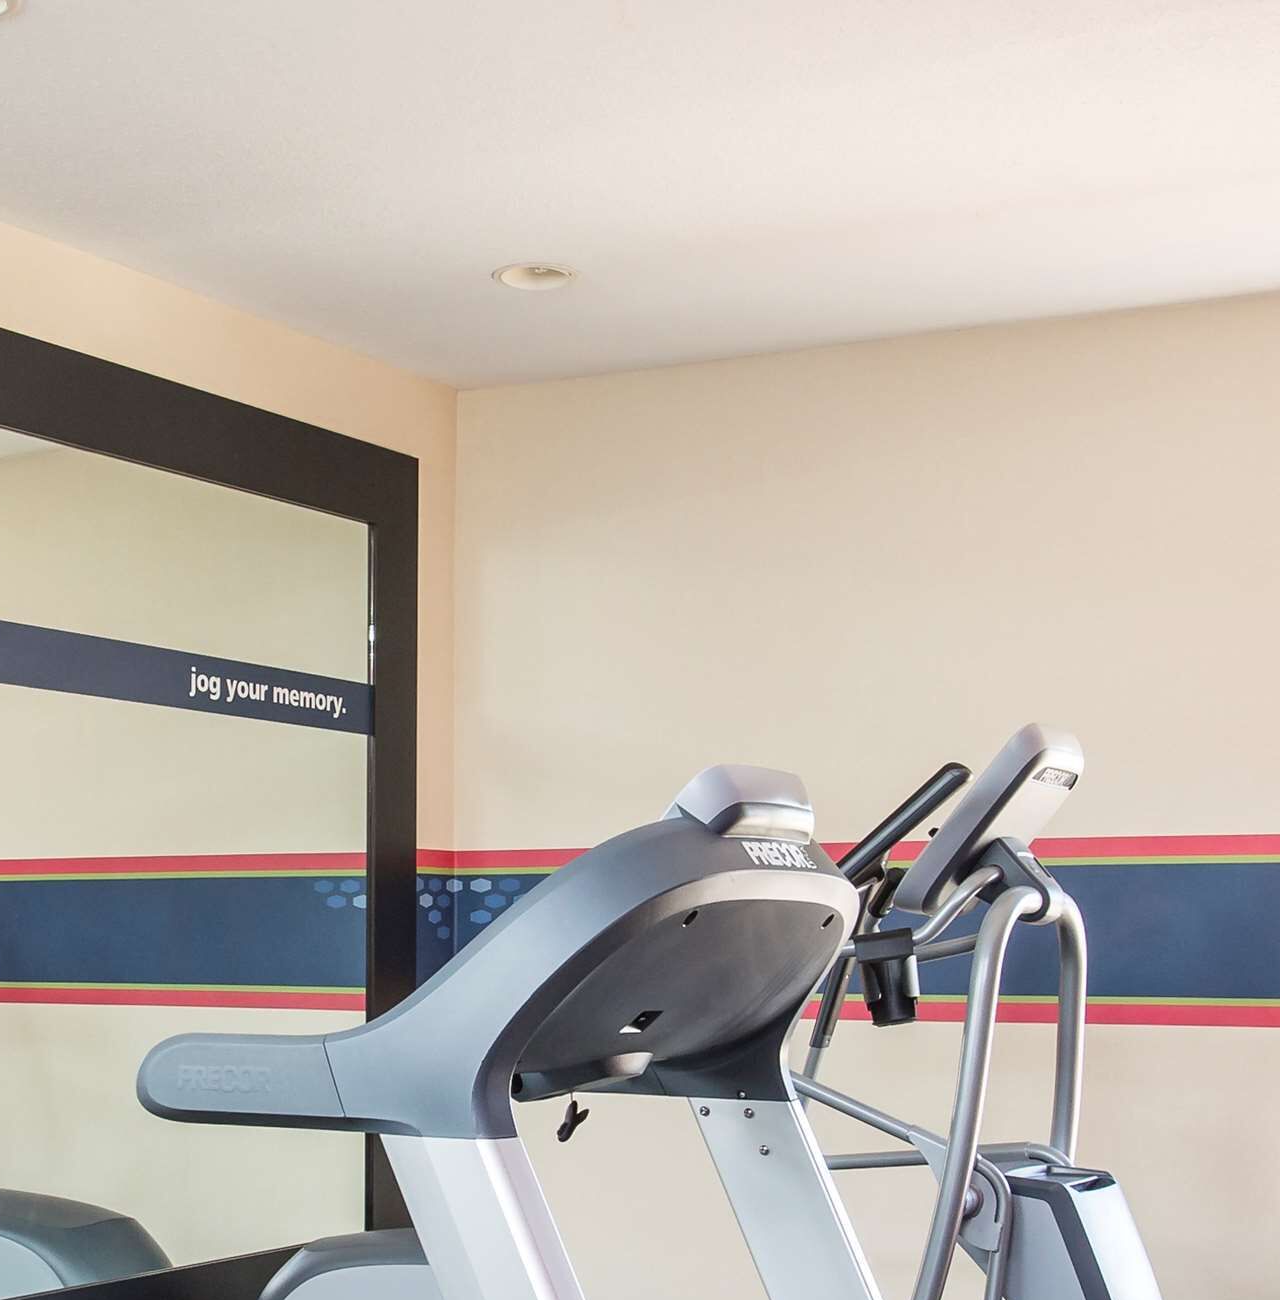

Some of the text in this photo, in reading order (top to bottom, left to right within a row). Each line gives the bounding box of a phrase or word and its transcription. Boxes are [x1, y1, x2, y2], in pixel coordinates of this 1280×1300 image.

[189, 666, 347, 718] jog your memory.
[740, 840, 806, 868] PRECOR
